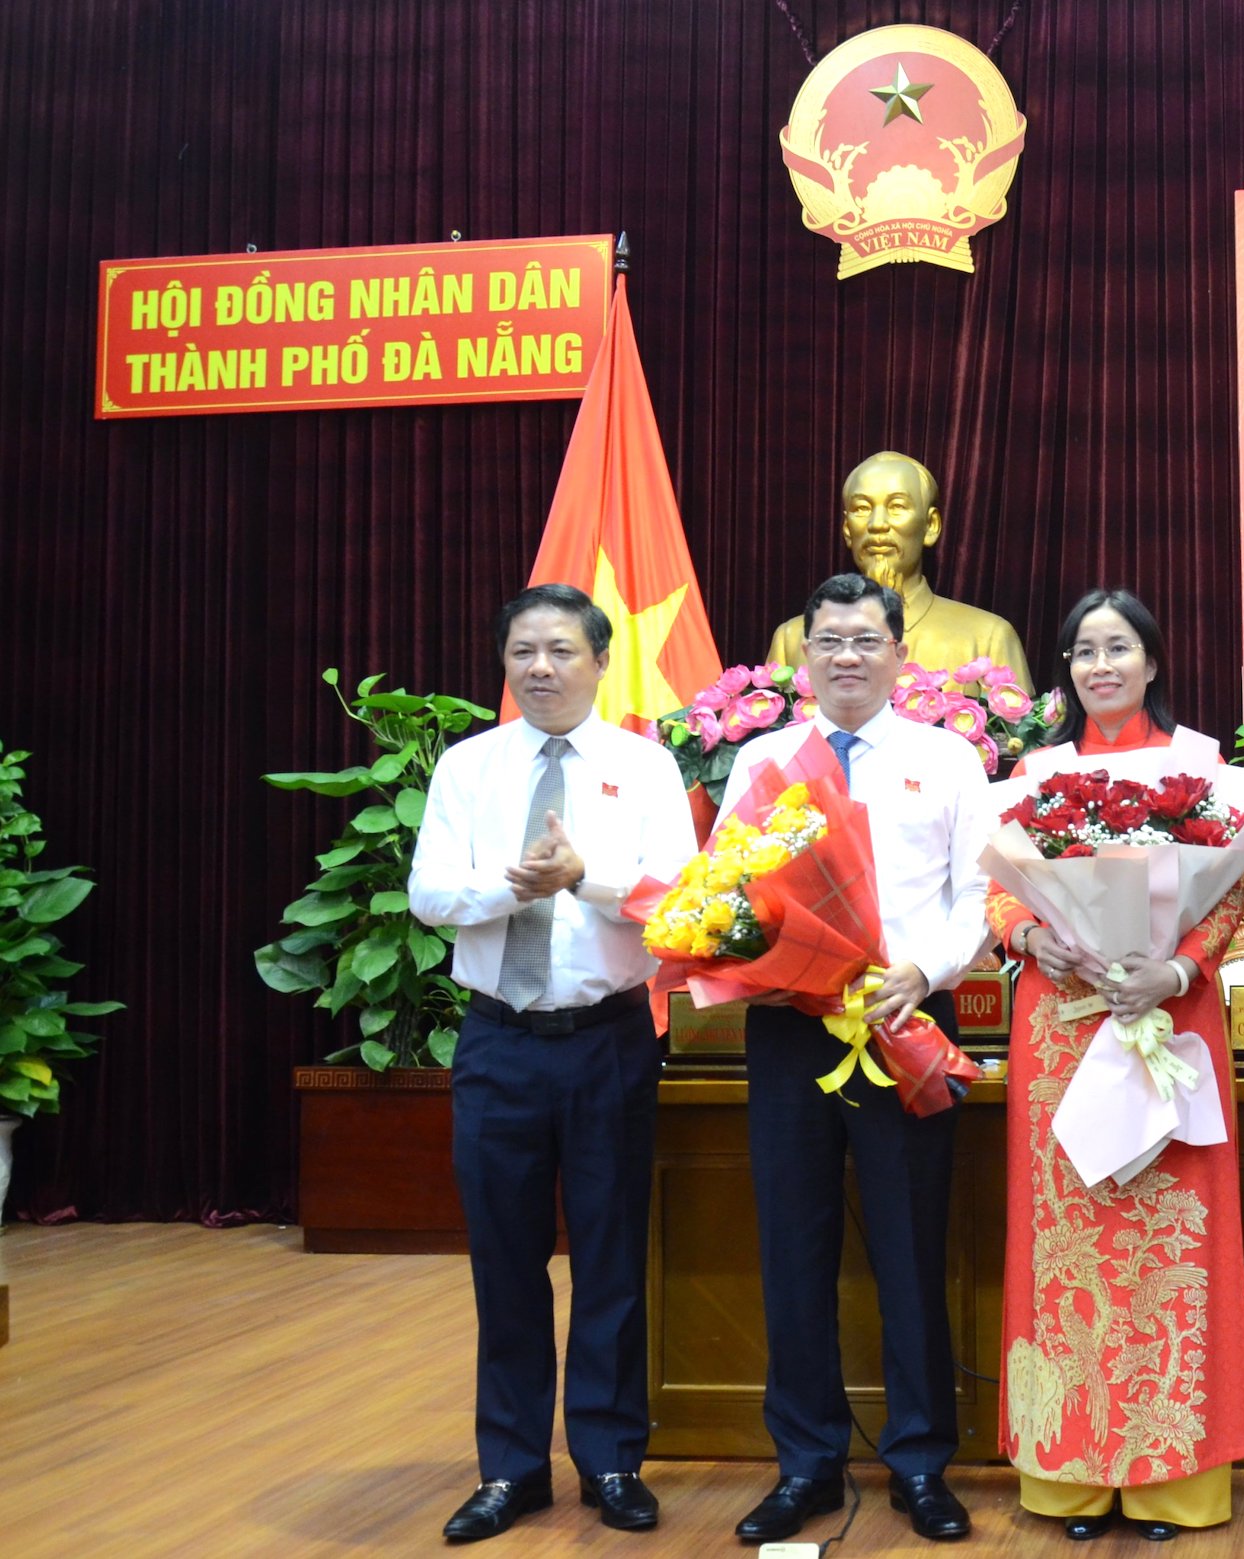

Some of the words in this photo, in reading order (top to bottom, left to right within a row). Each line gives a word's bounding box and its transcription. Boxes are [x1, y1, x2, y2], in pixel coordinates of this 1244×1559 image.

[859, 231, 902, 253] VIỆT
[907, 232, 950, 251] NAM
[132, 281, 201, 337] HỘI
[215, 270, 334, 325] ĐỒNG
[350, 267, 473, 319] NHÂN
[489, 261, 581, 311] DÂN
[127, 343, 266, 393] THÀNH
[282, 329, 370, 386] PHỐ
[382, 332, 442, 381] ĐÀ
[457, 321, 582, 378] NẴNG
[960, 994, 996, 1018] HỌP
